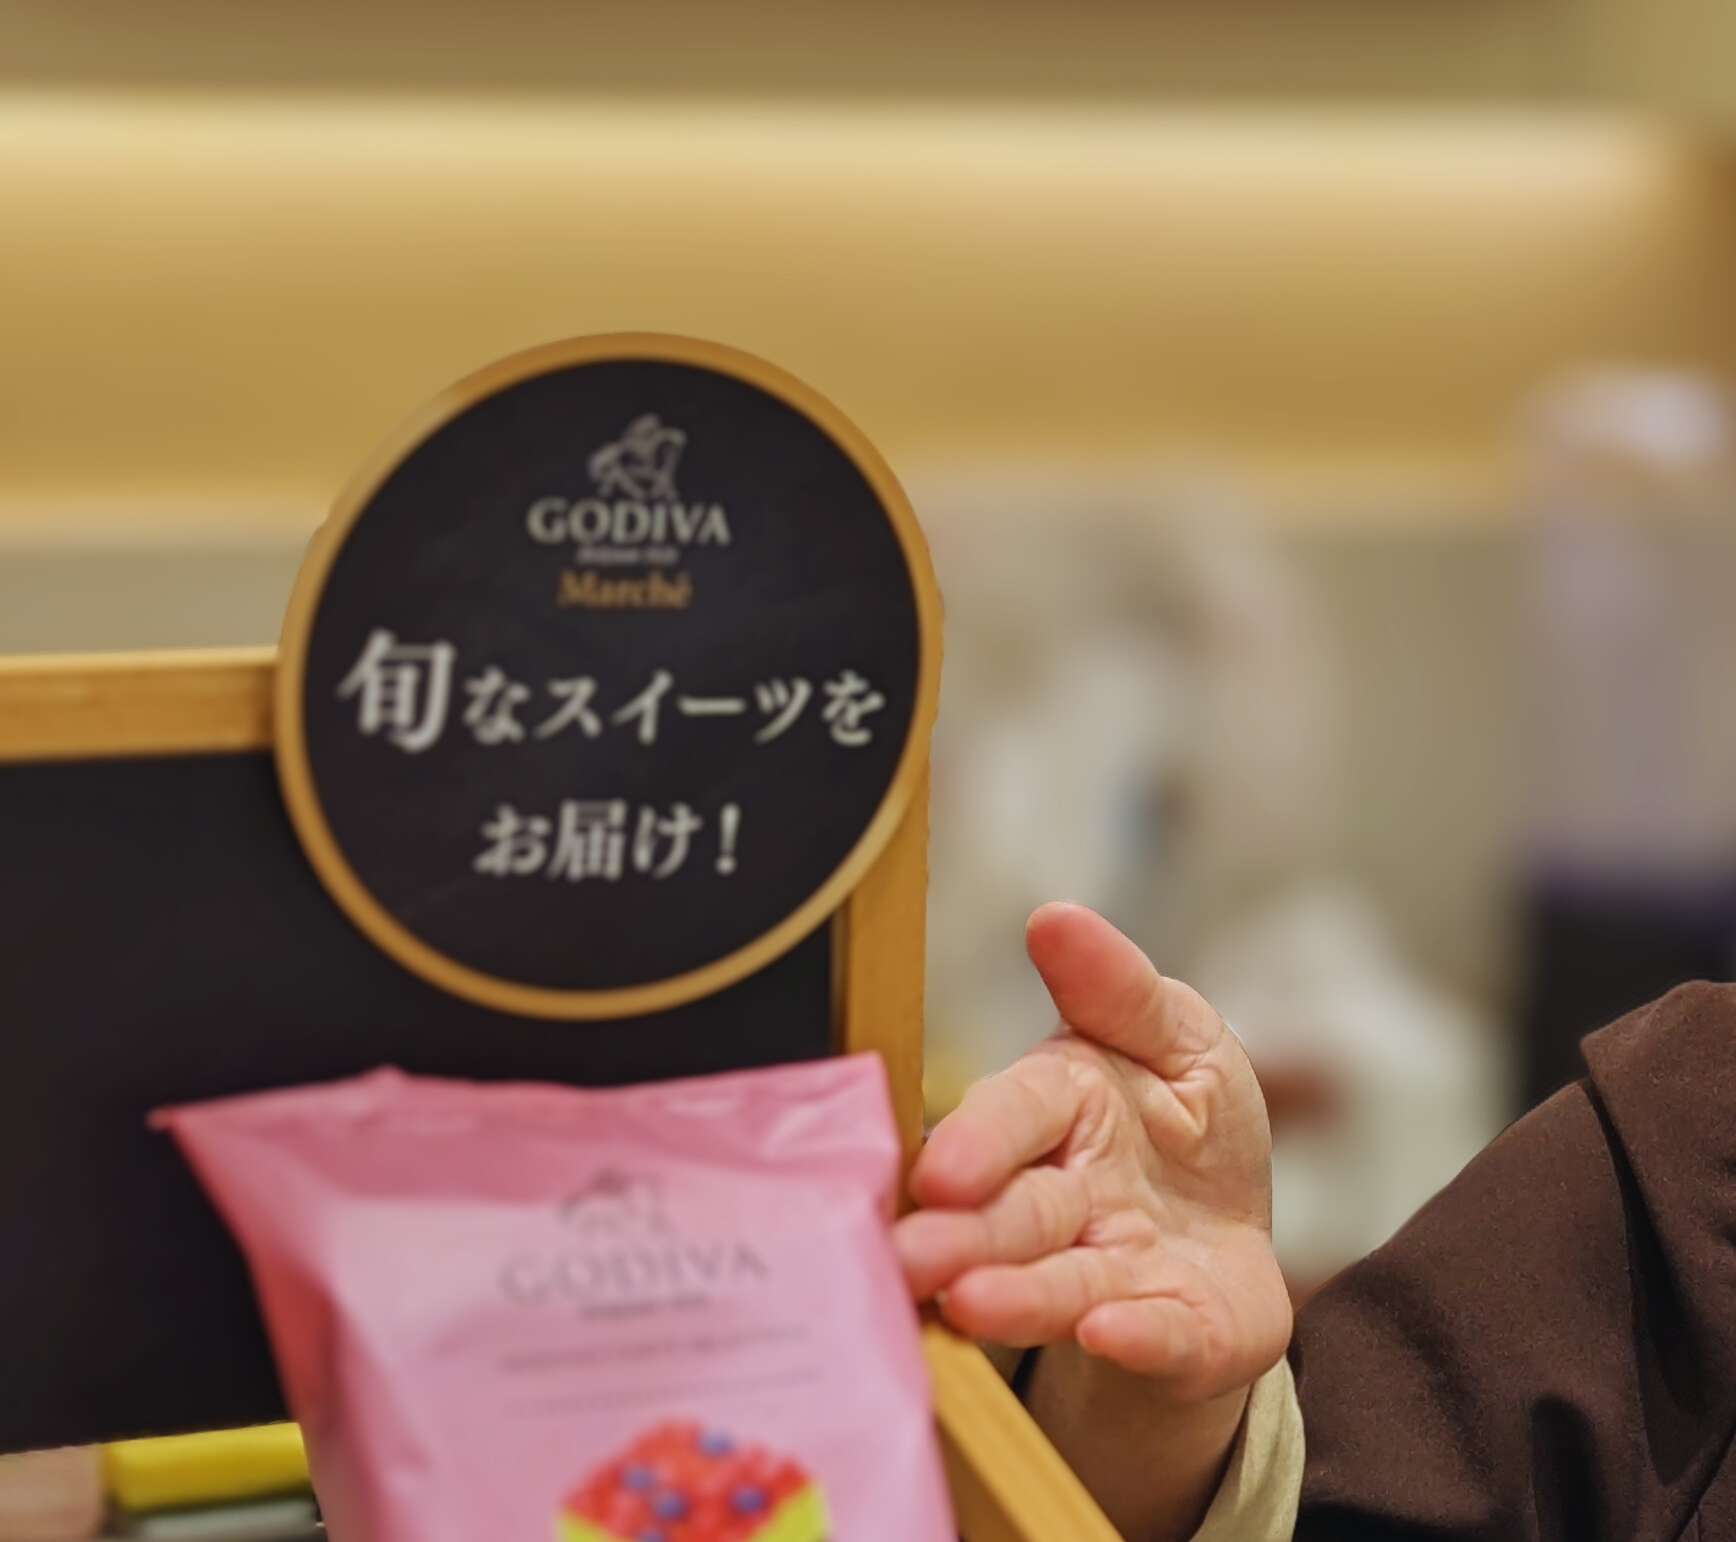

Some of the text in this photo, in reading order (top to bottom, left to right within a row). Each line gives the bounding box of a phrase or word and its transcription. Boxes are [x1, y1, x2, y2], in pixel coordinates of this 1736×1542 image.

[526, 496, 732, 546] GODIVA
[336, 629, 886, 752] 旬なスイーツを
[473, 799, 740, 880] お届け！
